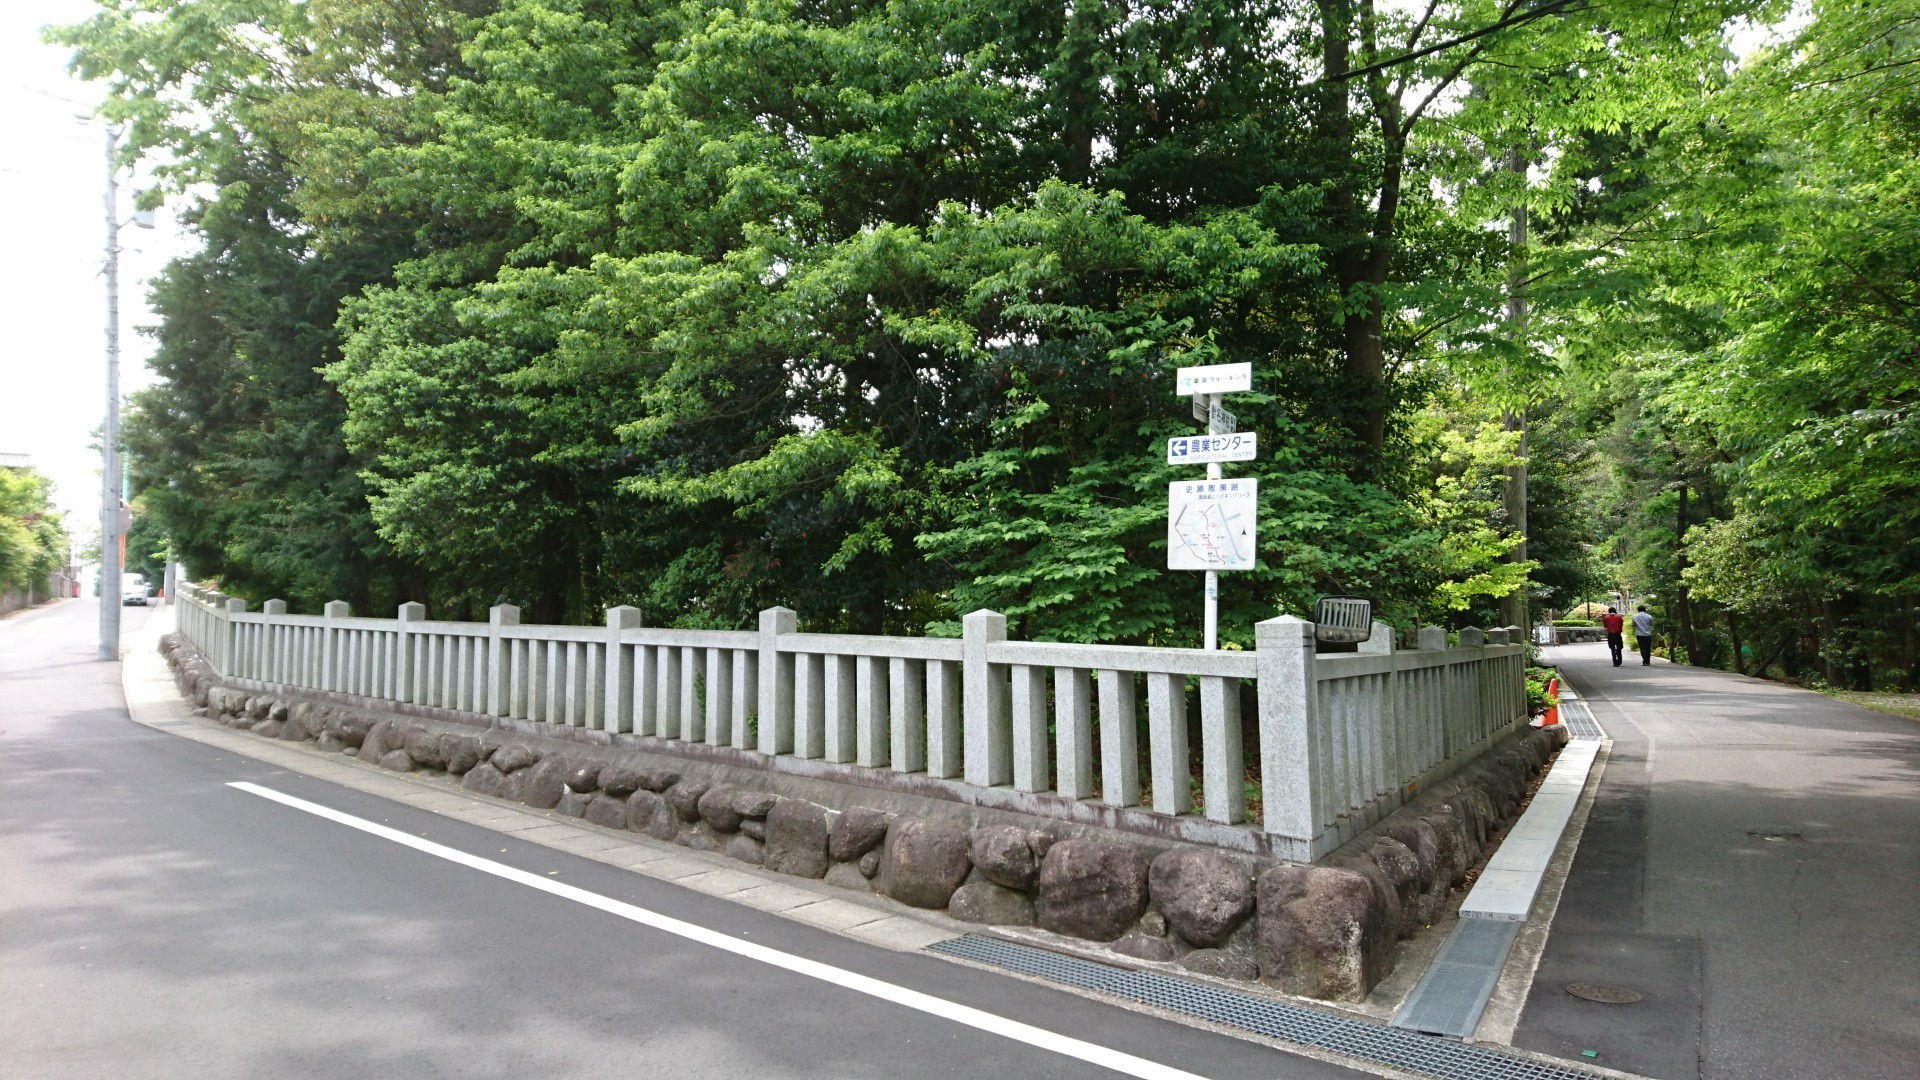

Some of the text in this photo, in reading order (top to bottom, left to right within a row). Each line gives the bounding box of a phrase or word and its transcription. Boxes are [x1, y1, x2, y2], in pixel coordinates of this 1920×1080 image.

[1191, 436, 1251, 452] 農業センター
